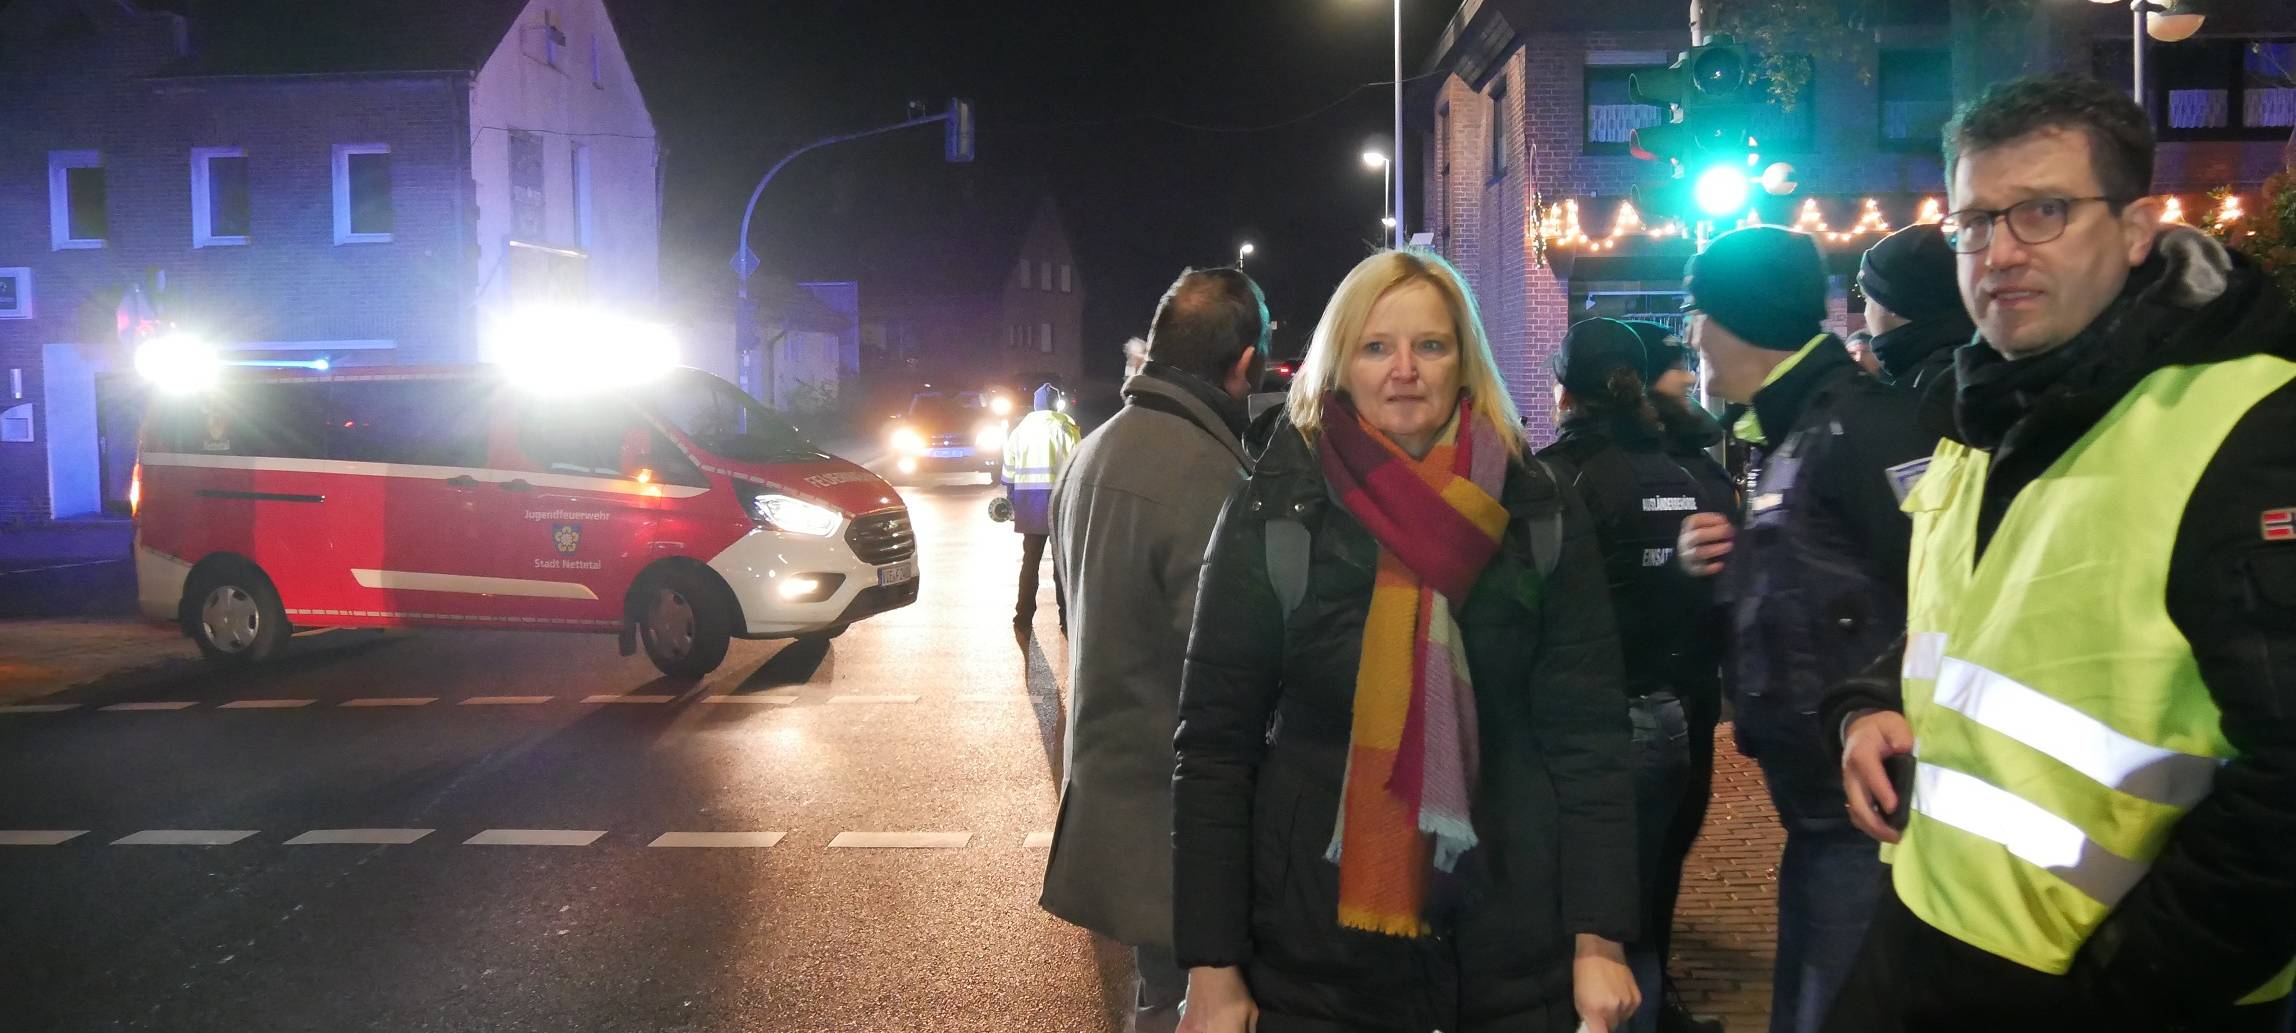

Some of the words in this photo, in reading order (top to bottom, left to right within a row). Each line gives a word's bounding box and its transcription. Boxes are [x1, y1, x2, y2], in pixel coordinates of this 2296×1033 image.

[524, 510, 610, 521] Jugendfeuerwehr
[1642, 548, 1674, 567] EINSAT
[534, 559, 560, 568] Stadt
[562, 560, 601, 570] Nettetal
